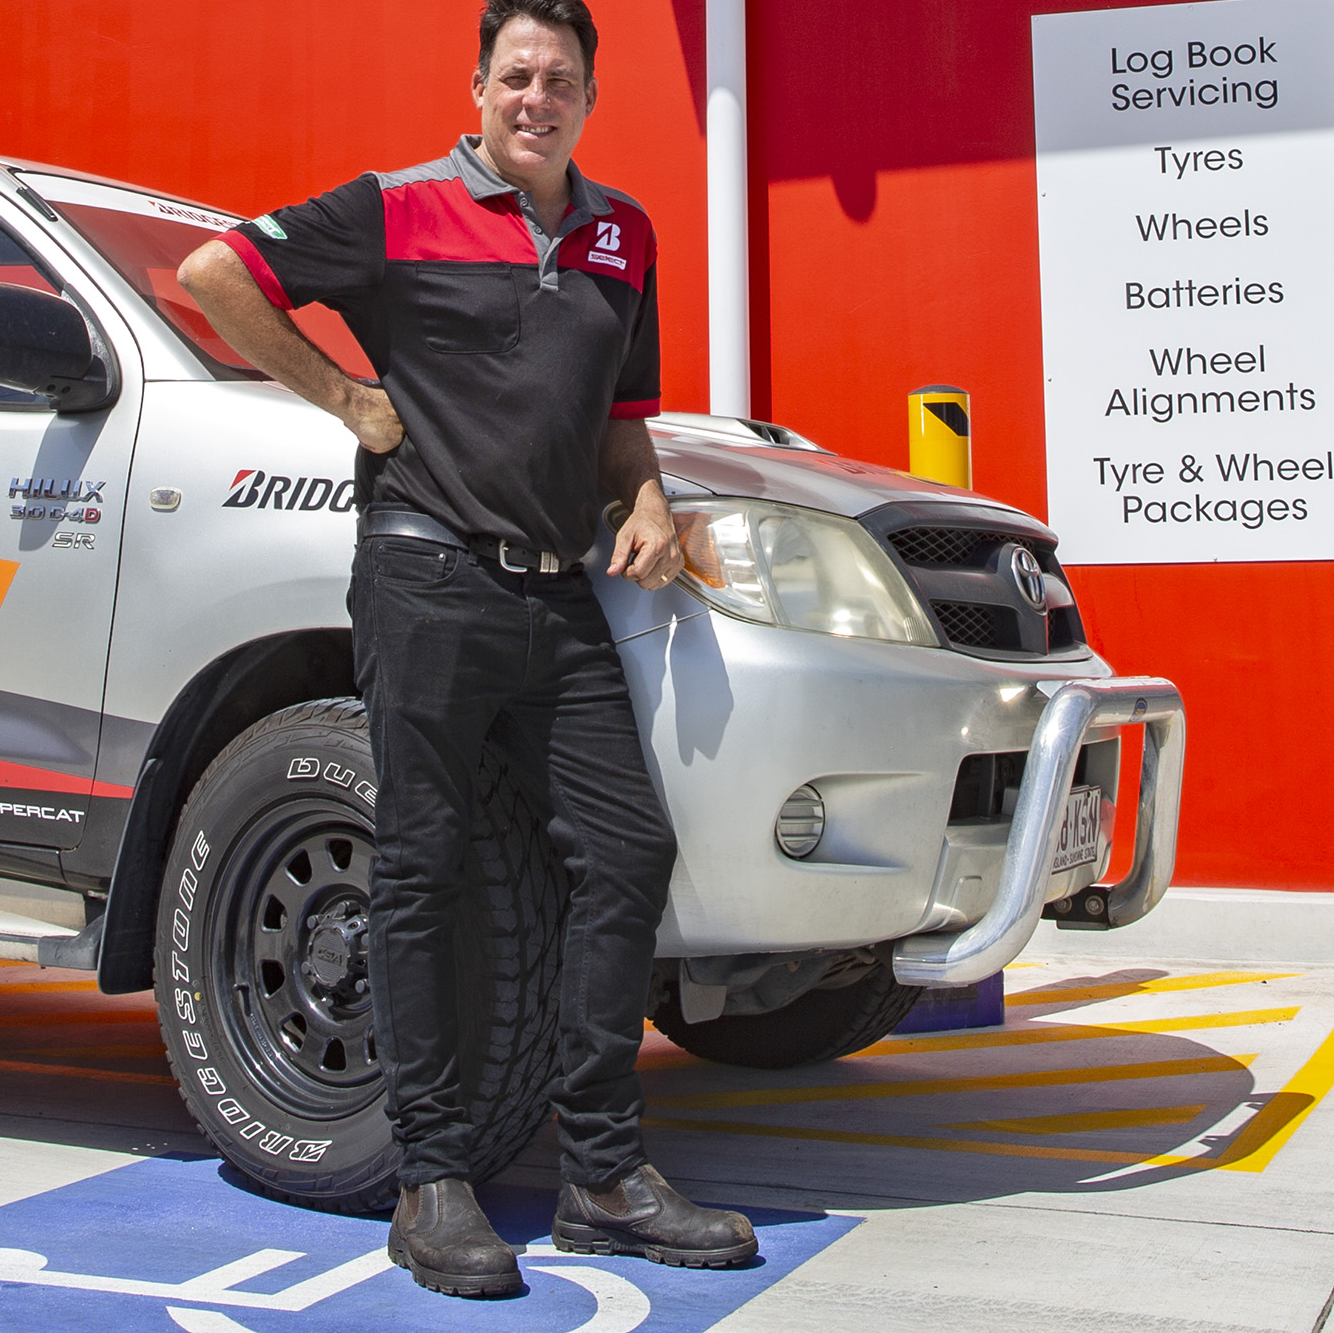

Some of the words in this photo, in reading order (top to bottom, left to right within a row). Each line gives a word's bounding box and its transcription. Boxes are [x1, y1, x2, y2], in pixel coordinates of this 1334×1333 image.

[1111, 46, 1175, 78] Log
[1187, 36, 1278, 70] Book
[1111, 75, 1280, 112] Servicing
[1154, 145, 1244, 180] Tyres
[1135, 208, 1270, 242] Wheels
[1125, 276, 1285, 311] Batteries
[1149, 344, 1267, 377] Wheel
[1104, 382, 1317, 423] Alignments
[1093, 457, 1165, 491] Tyre
[1179, 454, 1205, 484] &
[1215, 451, 1334, 482] Wheel
[8, 477, 107, 504] HILUX
[1122, 494, 1309, 530] Packages
[51, 531, 96, 550] SR
[168, 830, 334, 1164] BRIDGESTONE
